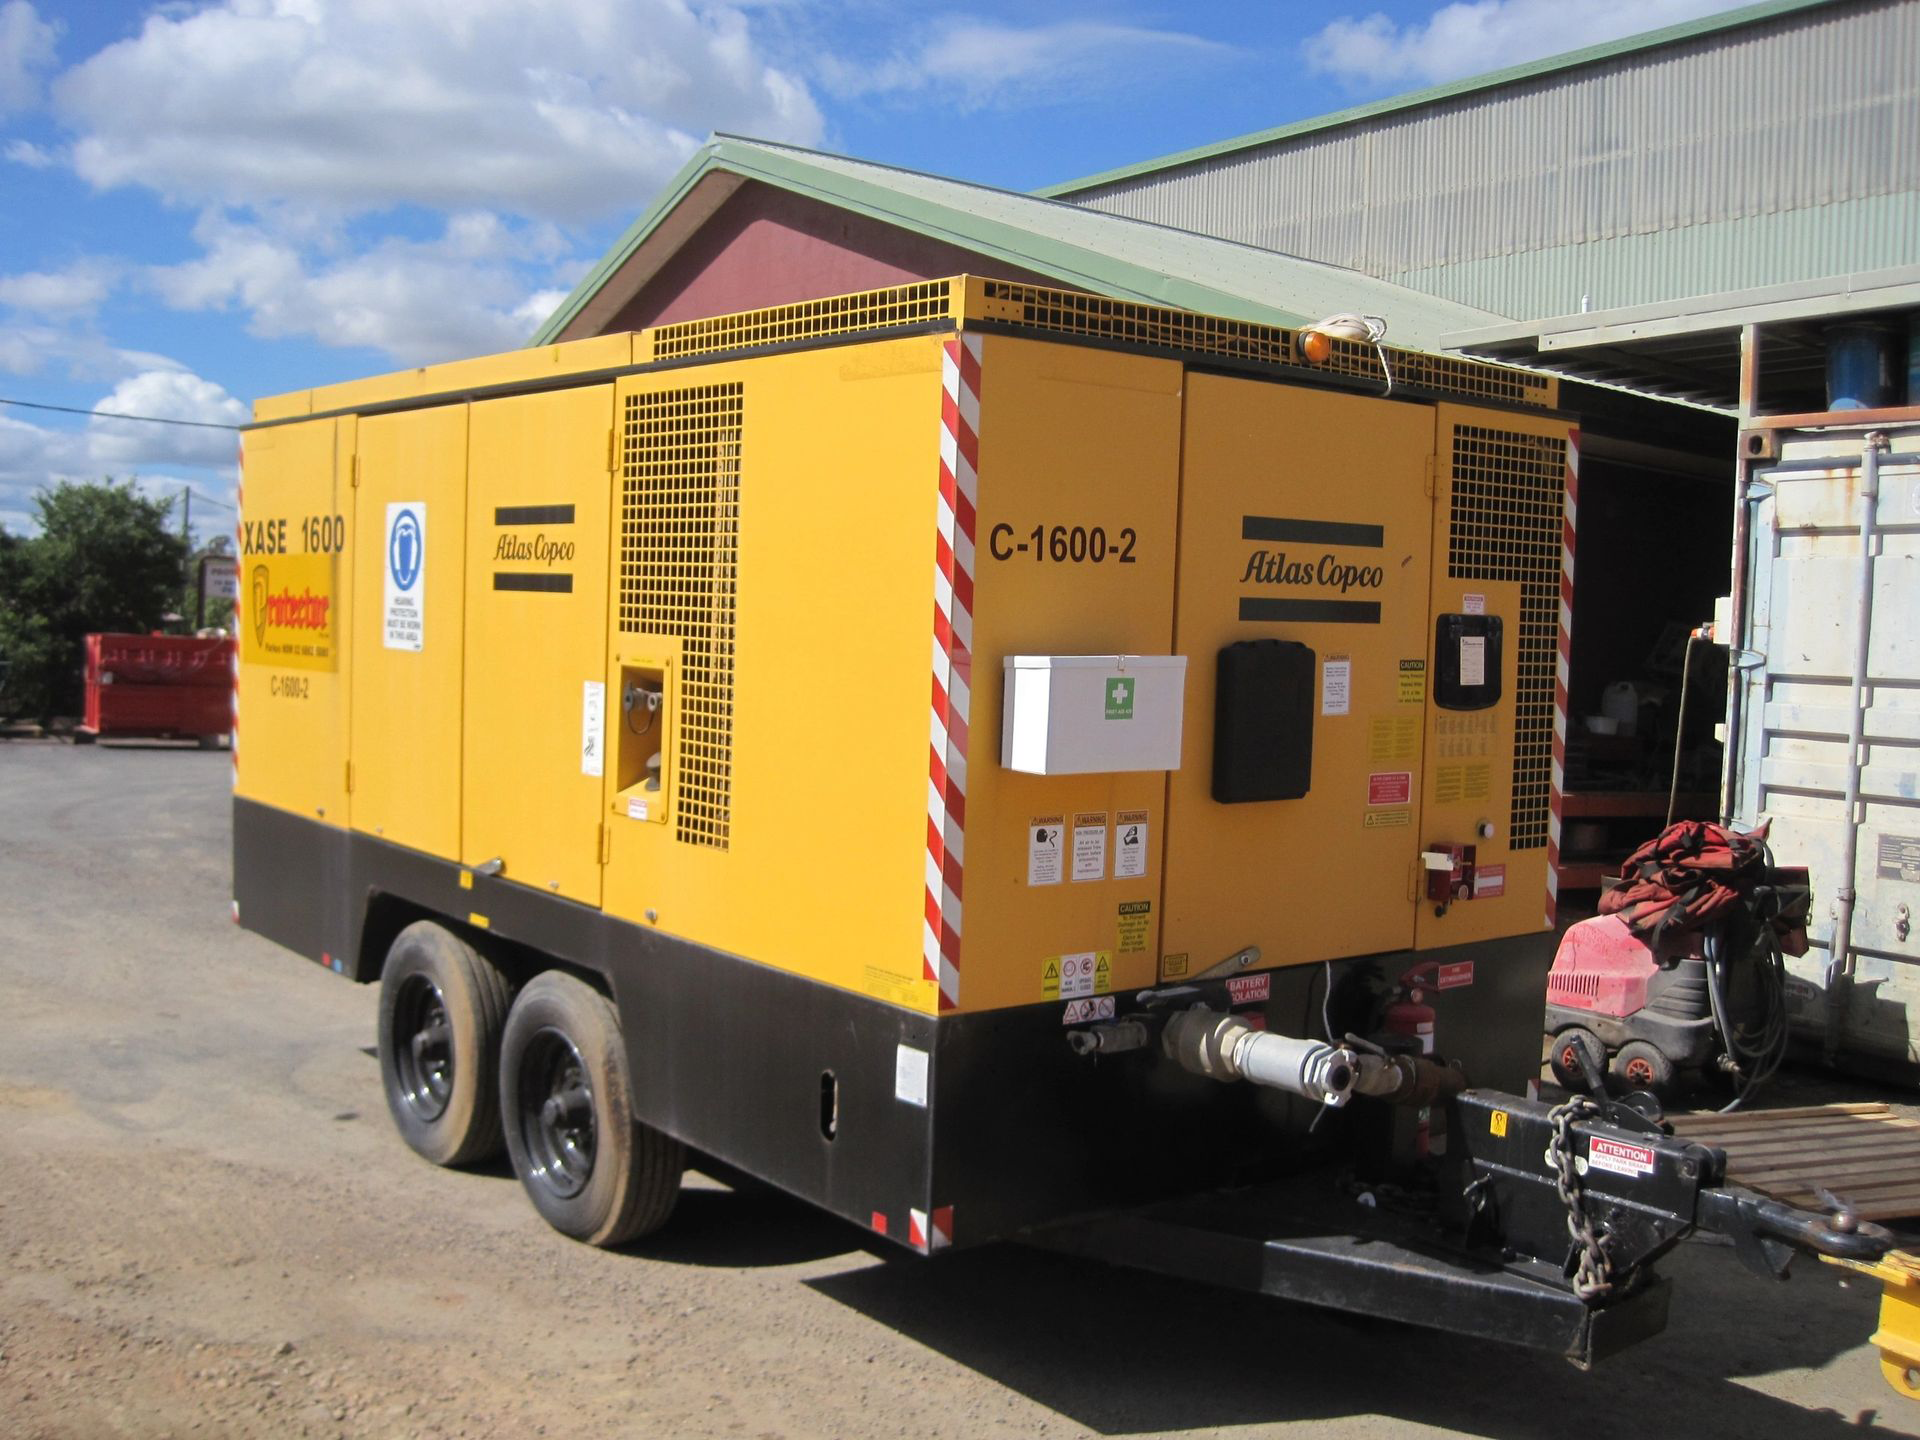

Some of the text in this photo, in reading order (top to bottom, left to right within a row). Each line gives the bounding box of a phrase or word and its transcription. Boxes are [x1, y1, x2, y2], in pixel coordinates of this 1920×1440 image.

[244, 515, 345, 554] XASE 1600
[989, 523, 1137, 563] C-1600-2
[1401, 661, 1424, 669] CAUTION
[271, 675, 309, 699] C-1600-2
[1038, 815, 1064, 825] WARNING
[1082, 815, 1106, 825] WARNING
[1124, 813, 1147, 822] WARNING
[1120, 903, 1149, 913] CAUTION
[1230, 977, 1265, 991] BATTERY
[1596, 1142, 1648, 1162] ATTENTION
